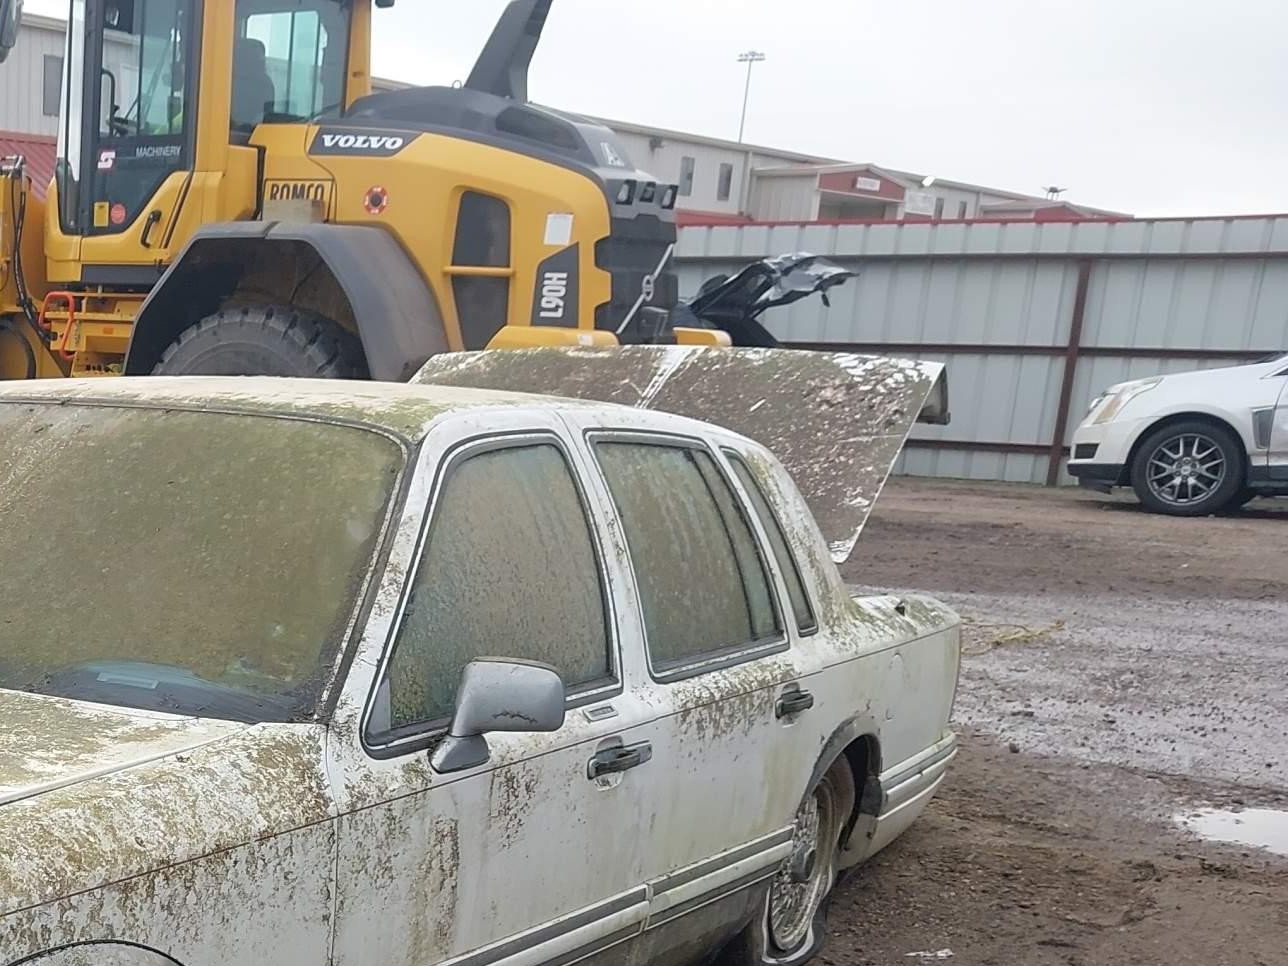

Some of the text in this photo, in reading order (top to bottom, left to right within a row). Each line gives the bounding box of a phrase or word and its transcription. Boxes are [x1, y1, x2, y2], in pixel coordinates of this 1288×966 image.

[322, 134, 403, 149] VOLVO
[136, 145, 181, 158] MACHINERY
[540, 272, 568, 318] L90H
